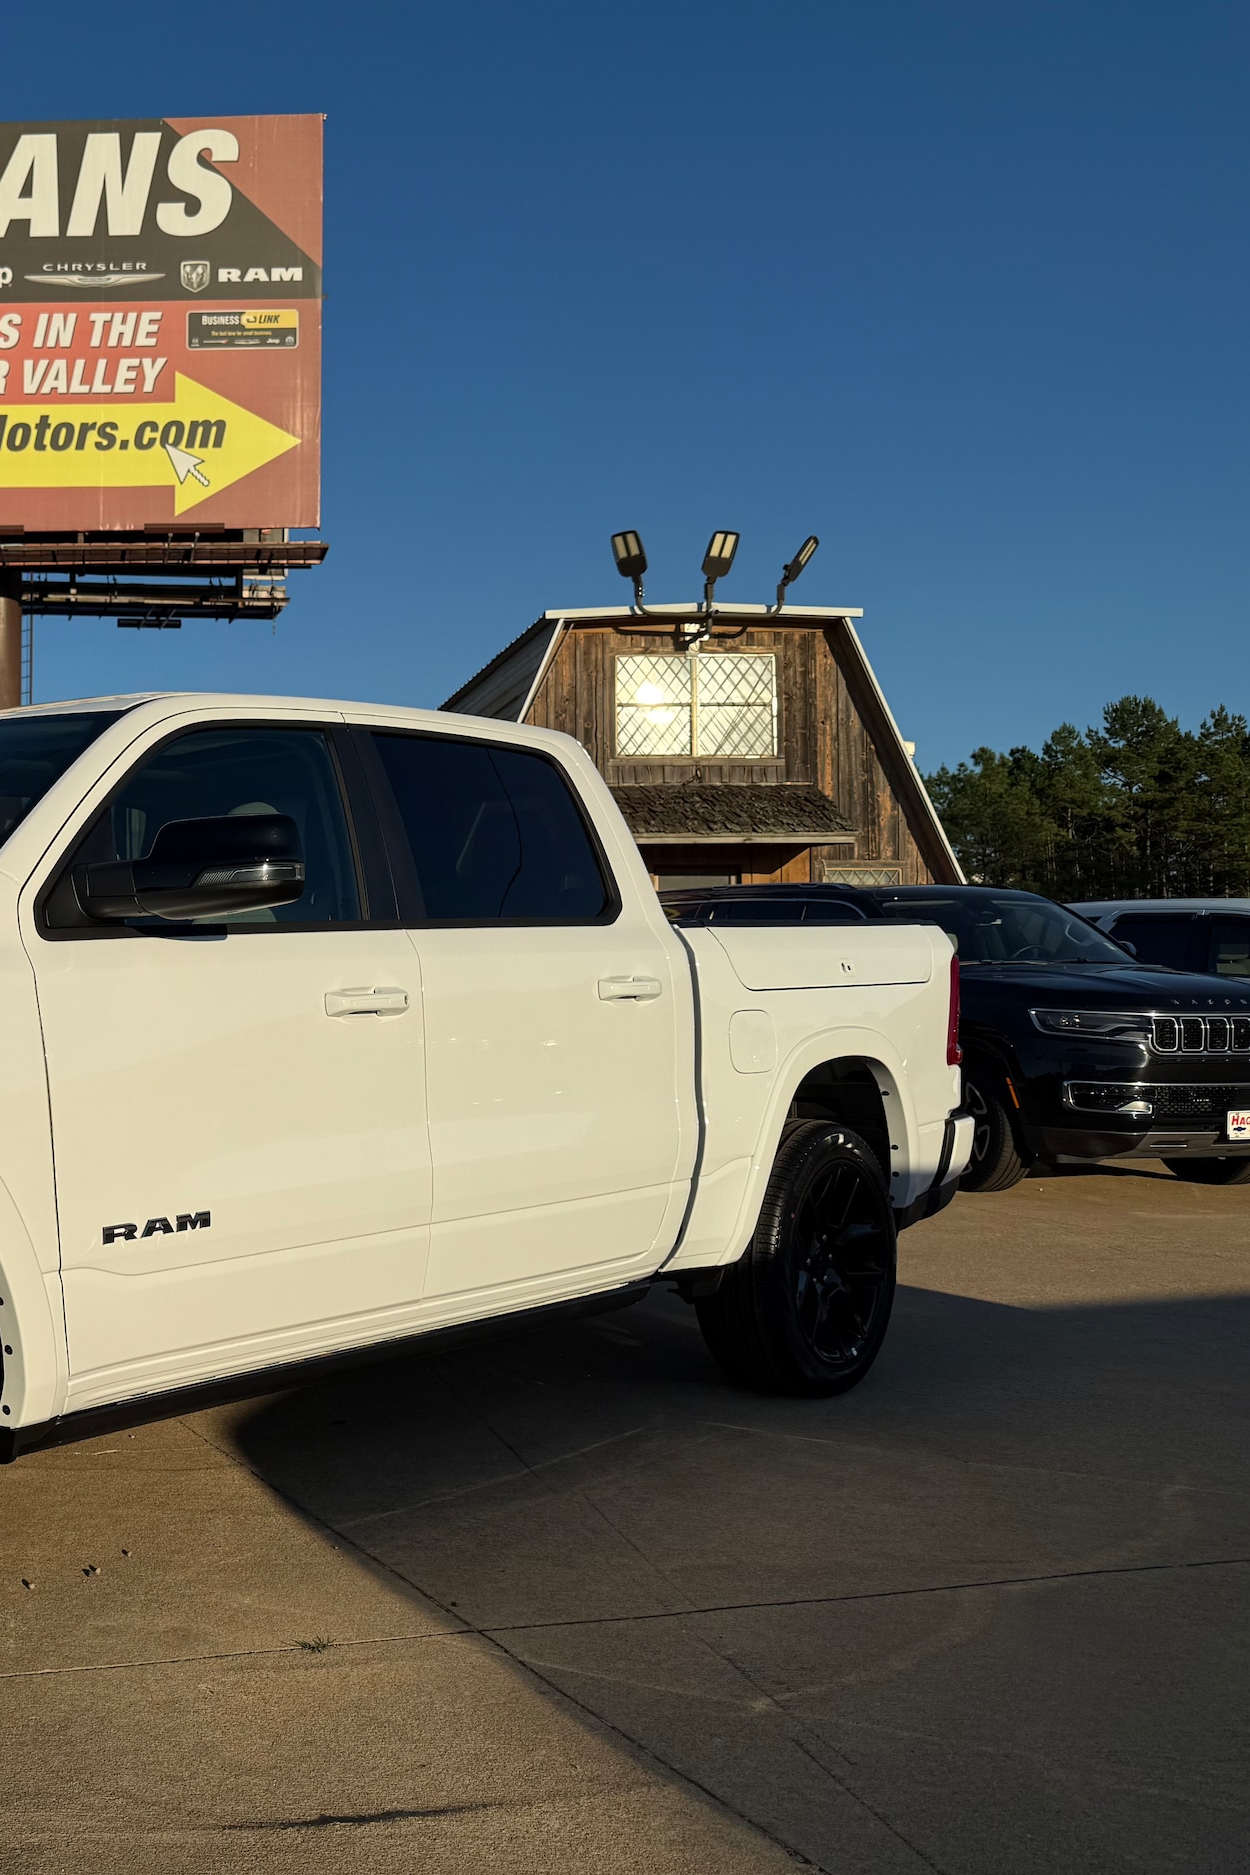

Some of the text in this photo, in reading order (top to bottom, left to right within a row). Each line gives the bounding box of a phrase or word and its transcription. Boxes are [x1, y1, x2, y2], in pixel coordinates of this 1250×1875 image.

[42, 261, 148, 272] CHRYSLER
[217, 267, 303, 283] RAM
[33, 312, 78, 348] IN
[88, 311, 163, 347] THE
[258, 314, 280, 324] LINK
[22, 357, 168, 395] VALLEY
[102, 1210, 211, 1245] RAM
